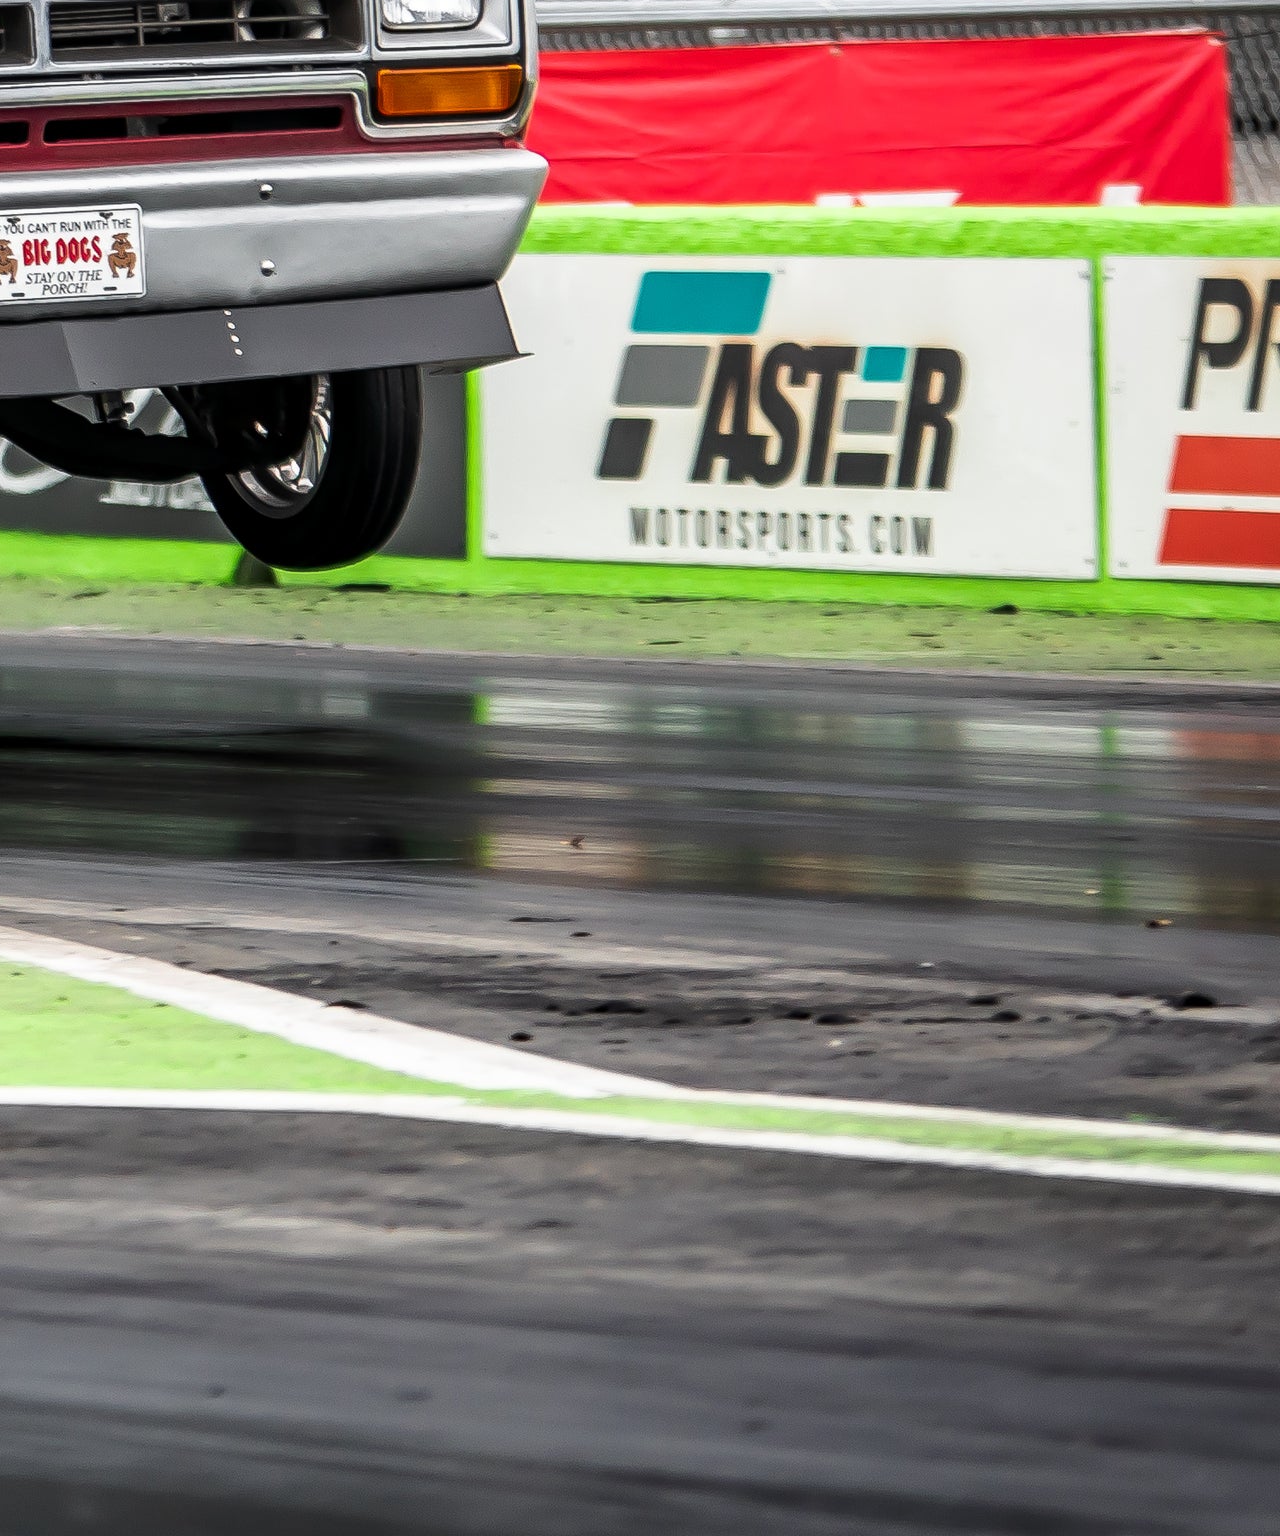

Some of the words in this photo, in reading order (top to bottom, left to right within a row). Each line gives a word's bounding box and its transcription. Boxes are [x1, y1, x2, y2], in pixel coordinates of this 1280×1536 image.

[4, 221, 24, 234] YOU
[28, 221, 56, 233] CAN'T
[60, 221, 81, 232] RUN
[84, 218, 109, 230] WITH
[112, 218, 132, 229] THE
[22, 238, 51, 266] BIG
[55, 235, 102, 264] DOGS
[25, 272, 54, 285] STAY
[57, 271, 75, 282] ON
[79, 269, 103, 281] THE
[42, 282, 88, 295] PORCH!
[629, 506, 934, 558] MOTORSPORTS.COM
